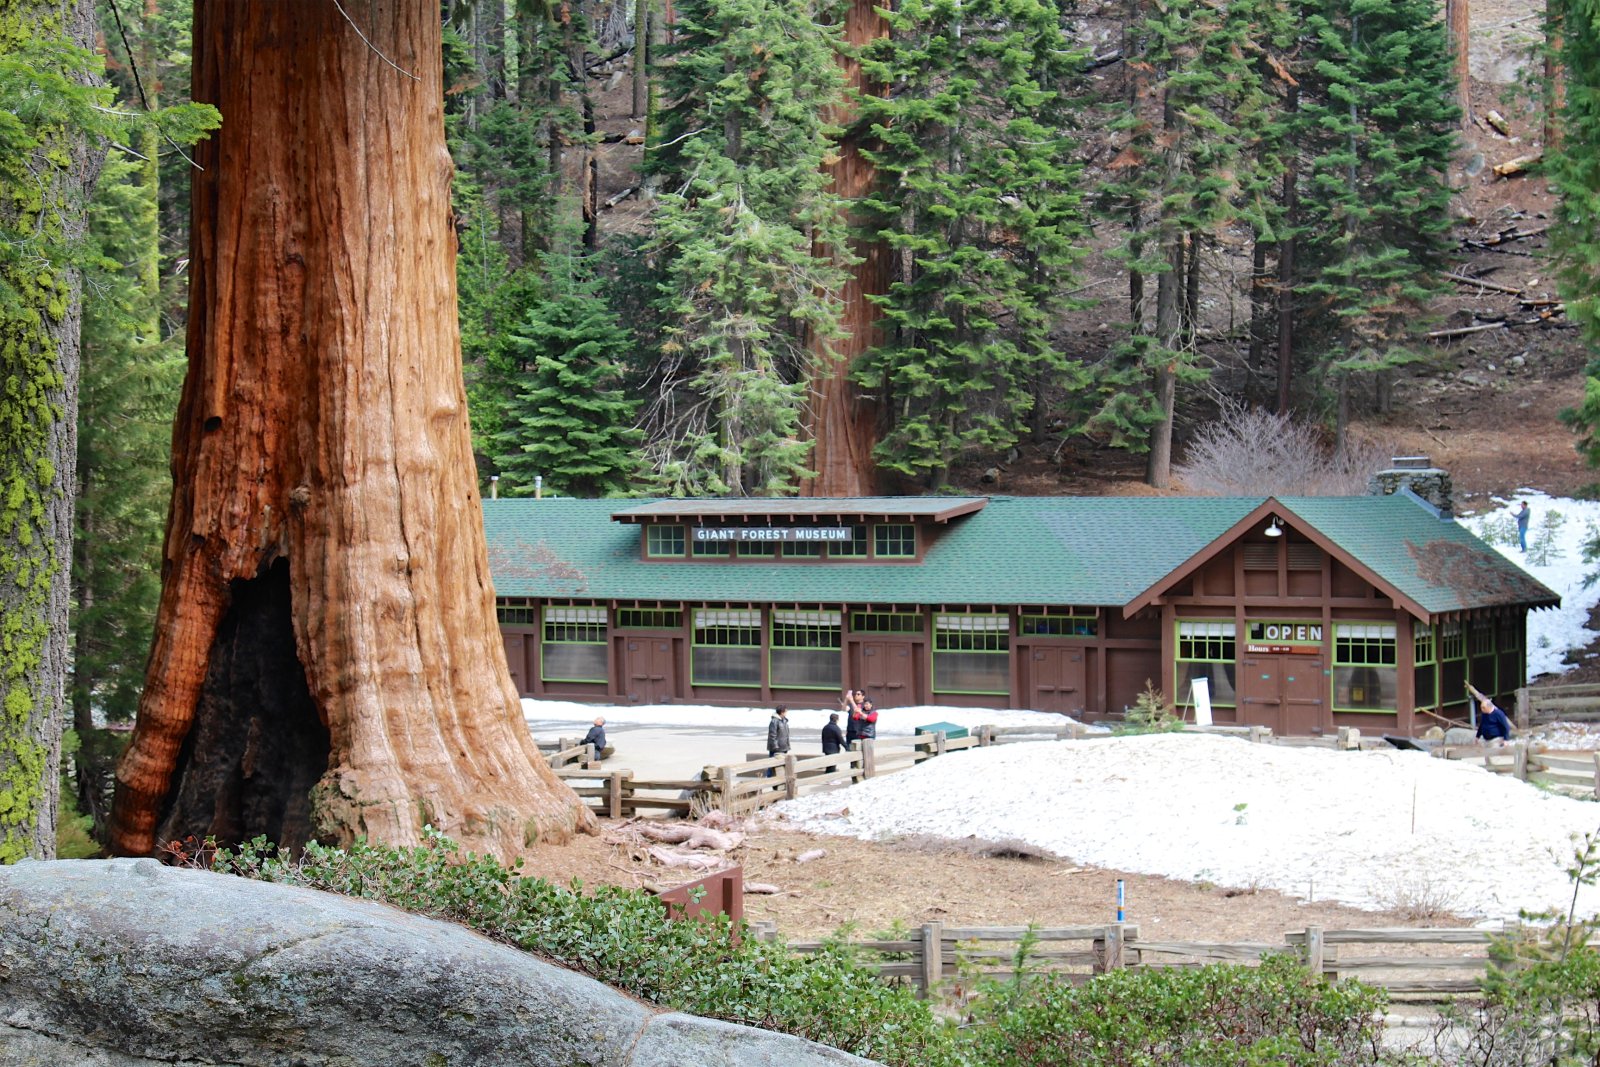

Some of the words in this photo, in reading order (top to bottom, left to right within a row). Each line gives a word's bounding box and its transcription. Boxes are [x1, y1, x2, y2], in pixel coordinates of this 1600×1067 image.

[697, 529, 735, 540] GIANT
[741, 529, 788, 540] FOREST
[795, 529, 846, 540] MUSEUM
[1266, 626, 1322, 640] OPEN
[1248, 644, 1269, 652] Hours
